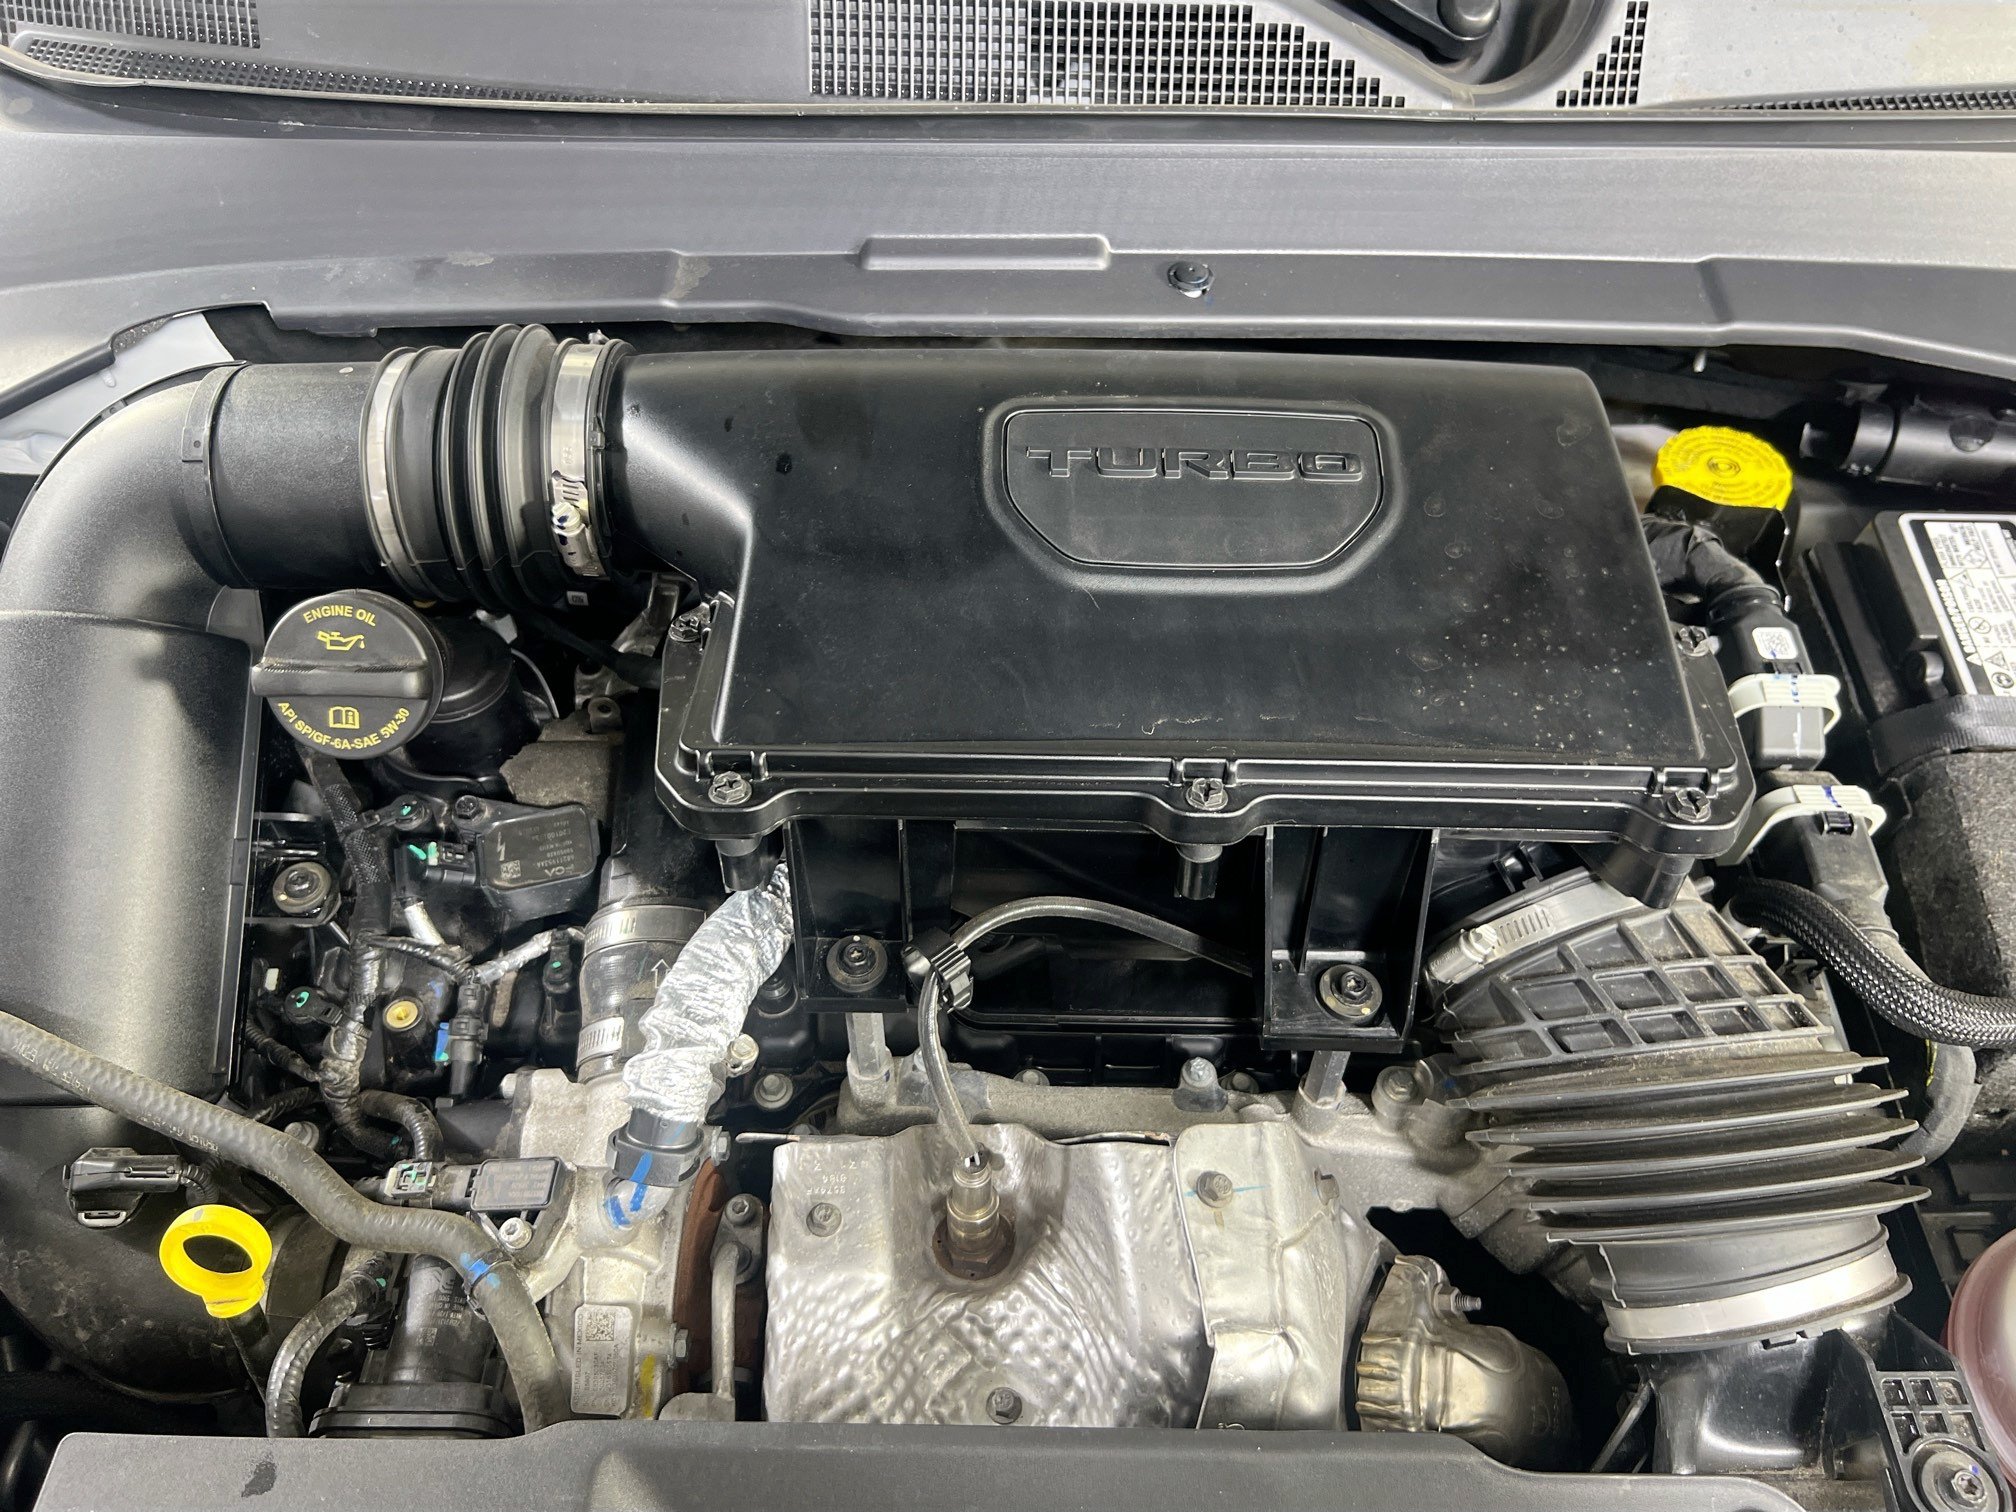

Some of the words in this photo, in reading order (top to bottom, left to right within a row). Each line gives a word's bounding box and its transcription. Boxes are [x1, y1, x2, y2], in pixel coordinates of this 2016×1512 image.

[1026, 447, 1364, 483] TURBO
[302, 604, 354, 625] ENGINE
[355, 606, 378, 627] OIL
[277, 700, 299, 723] API
[294, 717, 382, 751] SP/GF-6A-SAE
[380, 707, 411, 740] 5W-30
